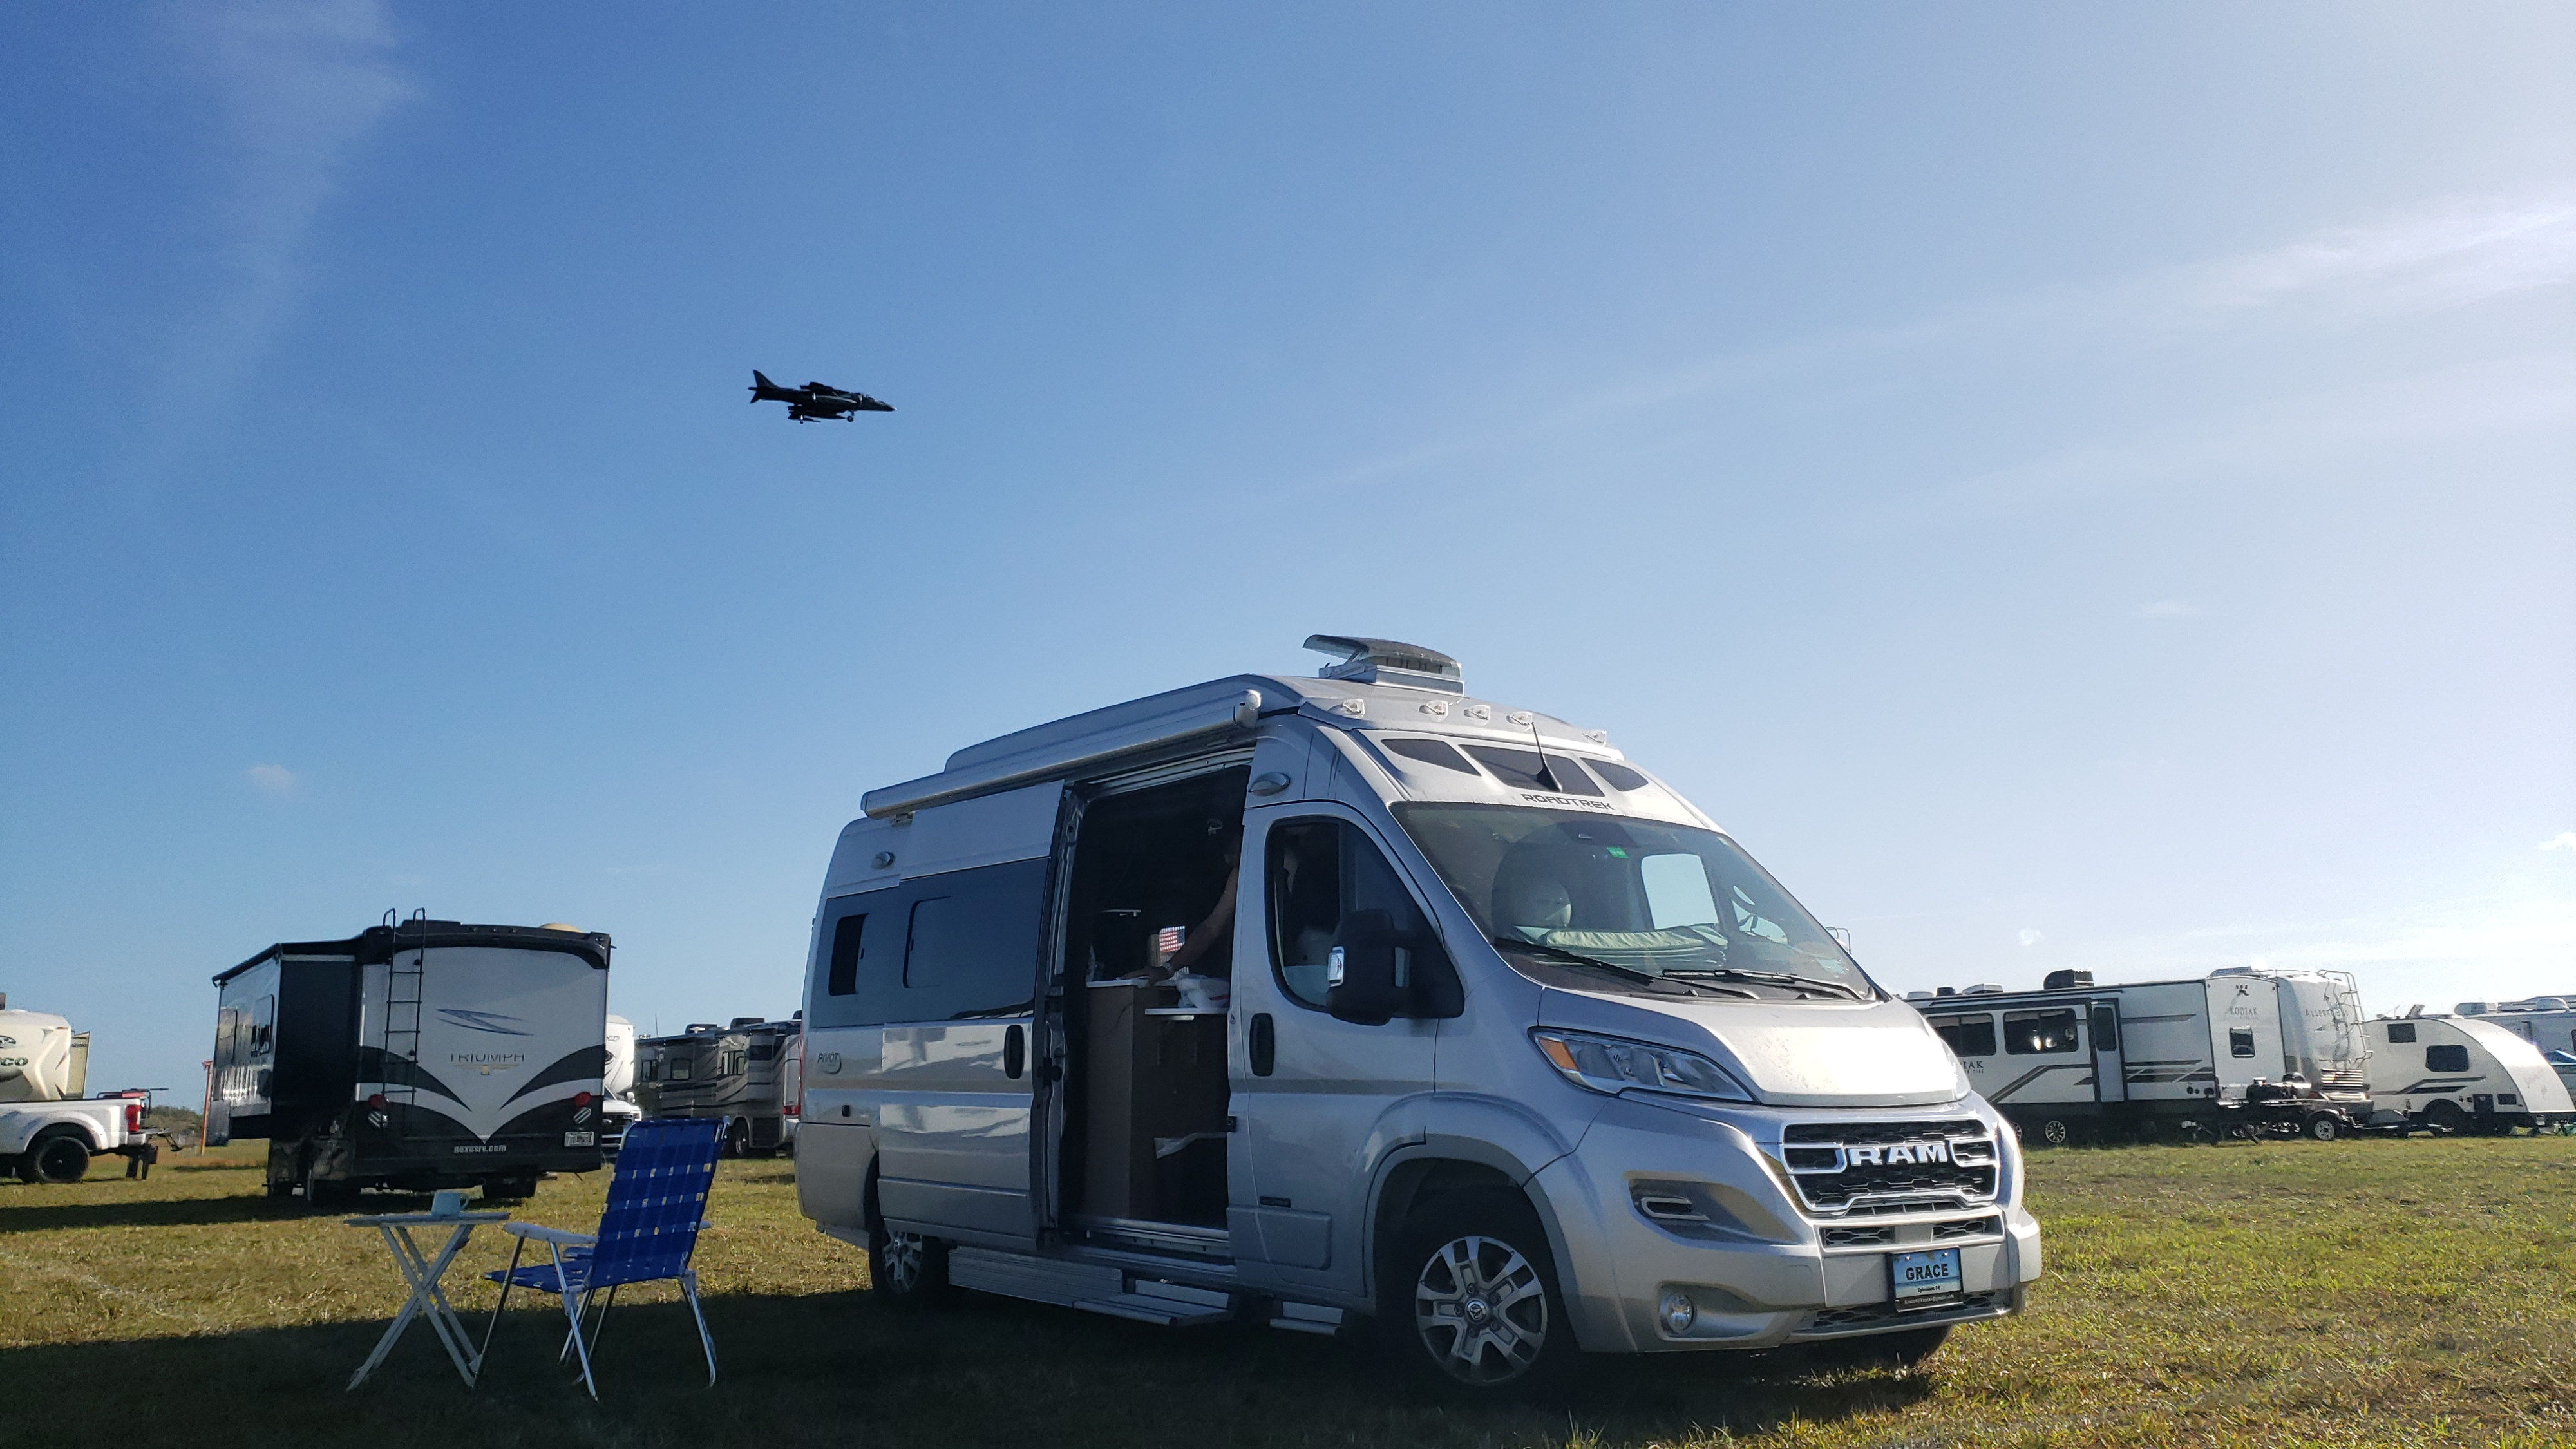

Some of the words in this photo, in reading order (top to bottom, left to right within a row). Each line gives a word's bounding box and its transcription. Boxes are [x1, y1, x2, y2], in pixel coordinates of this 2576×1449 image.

[1520, 793, 1616, 811] ROADTREK
[2230, 1007, 2258, 1016] KODIAK
[450, 1053, 525, 1063] TRIUMPH
[817, 1052, 840, 1063] PIVOT
[1960, 1061, 1984, 1069] IAK
[453, 1144, 507, 1153] nexusrv.com
[1847, 1144, 1948, 1166] RAM
[1905, 1263, 1949, 1281] GRACE
